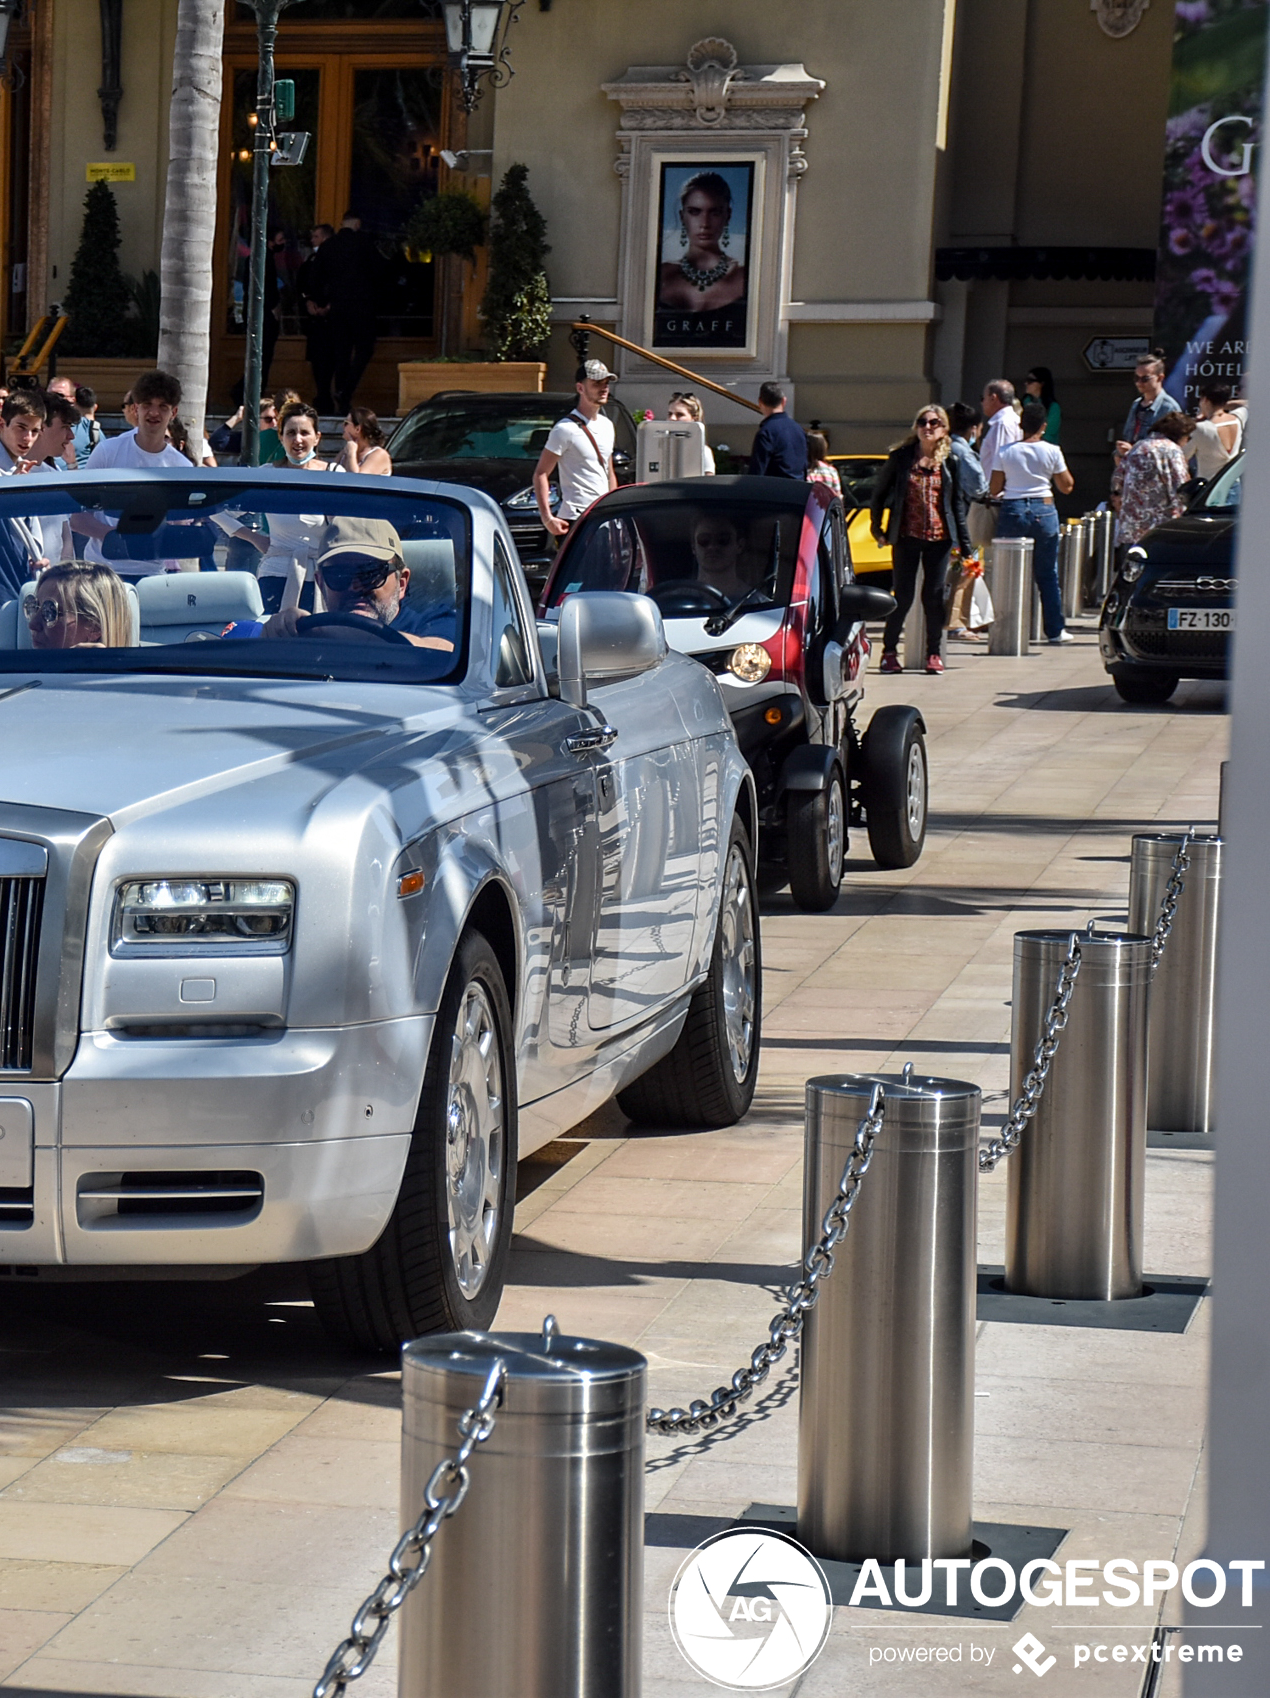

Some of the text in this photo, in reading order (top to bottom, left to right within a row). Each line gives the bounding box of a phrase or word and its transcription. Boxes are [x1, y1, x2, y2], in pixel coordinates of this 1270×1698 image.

[666, 320, 734, 331] GRAFF
[1186, 341, 1215, 354] WE
[1185, 359, 1244, 377] HÔTEL
[1197, 576, 1239, 590] 500
